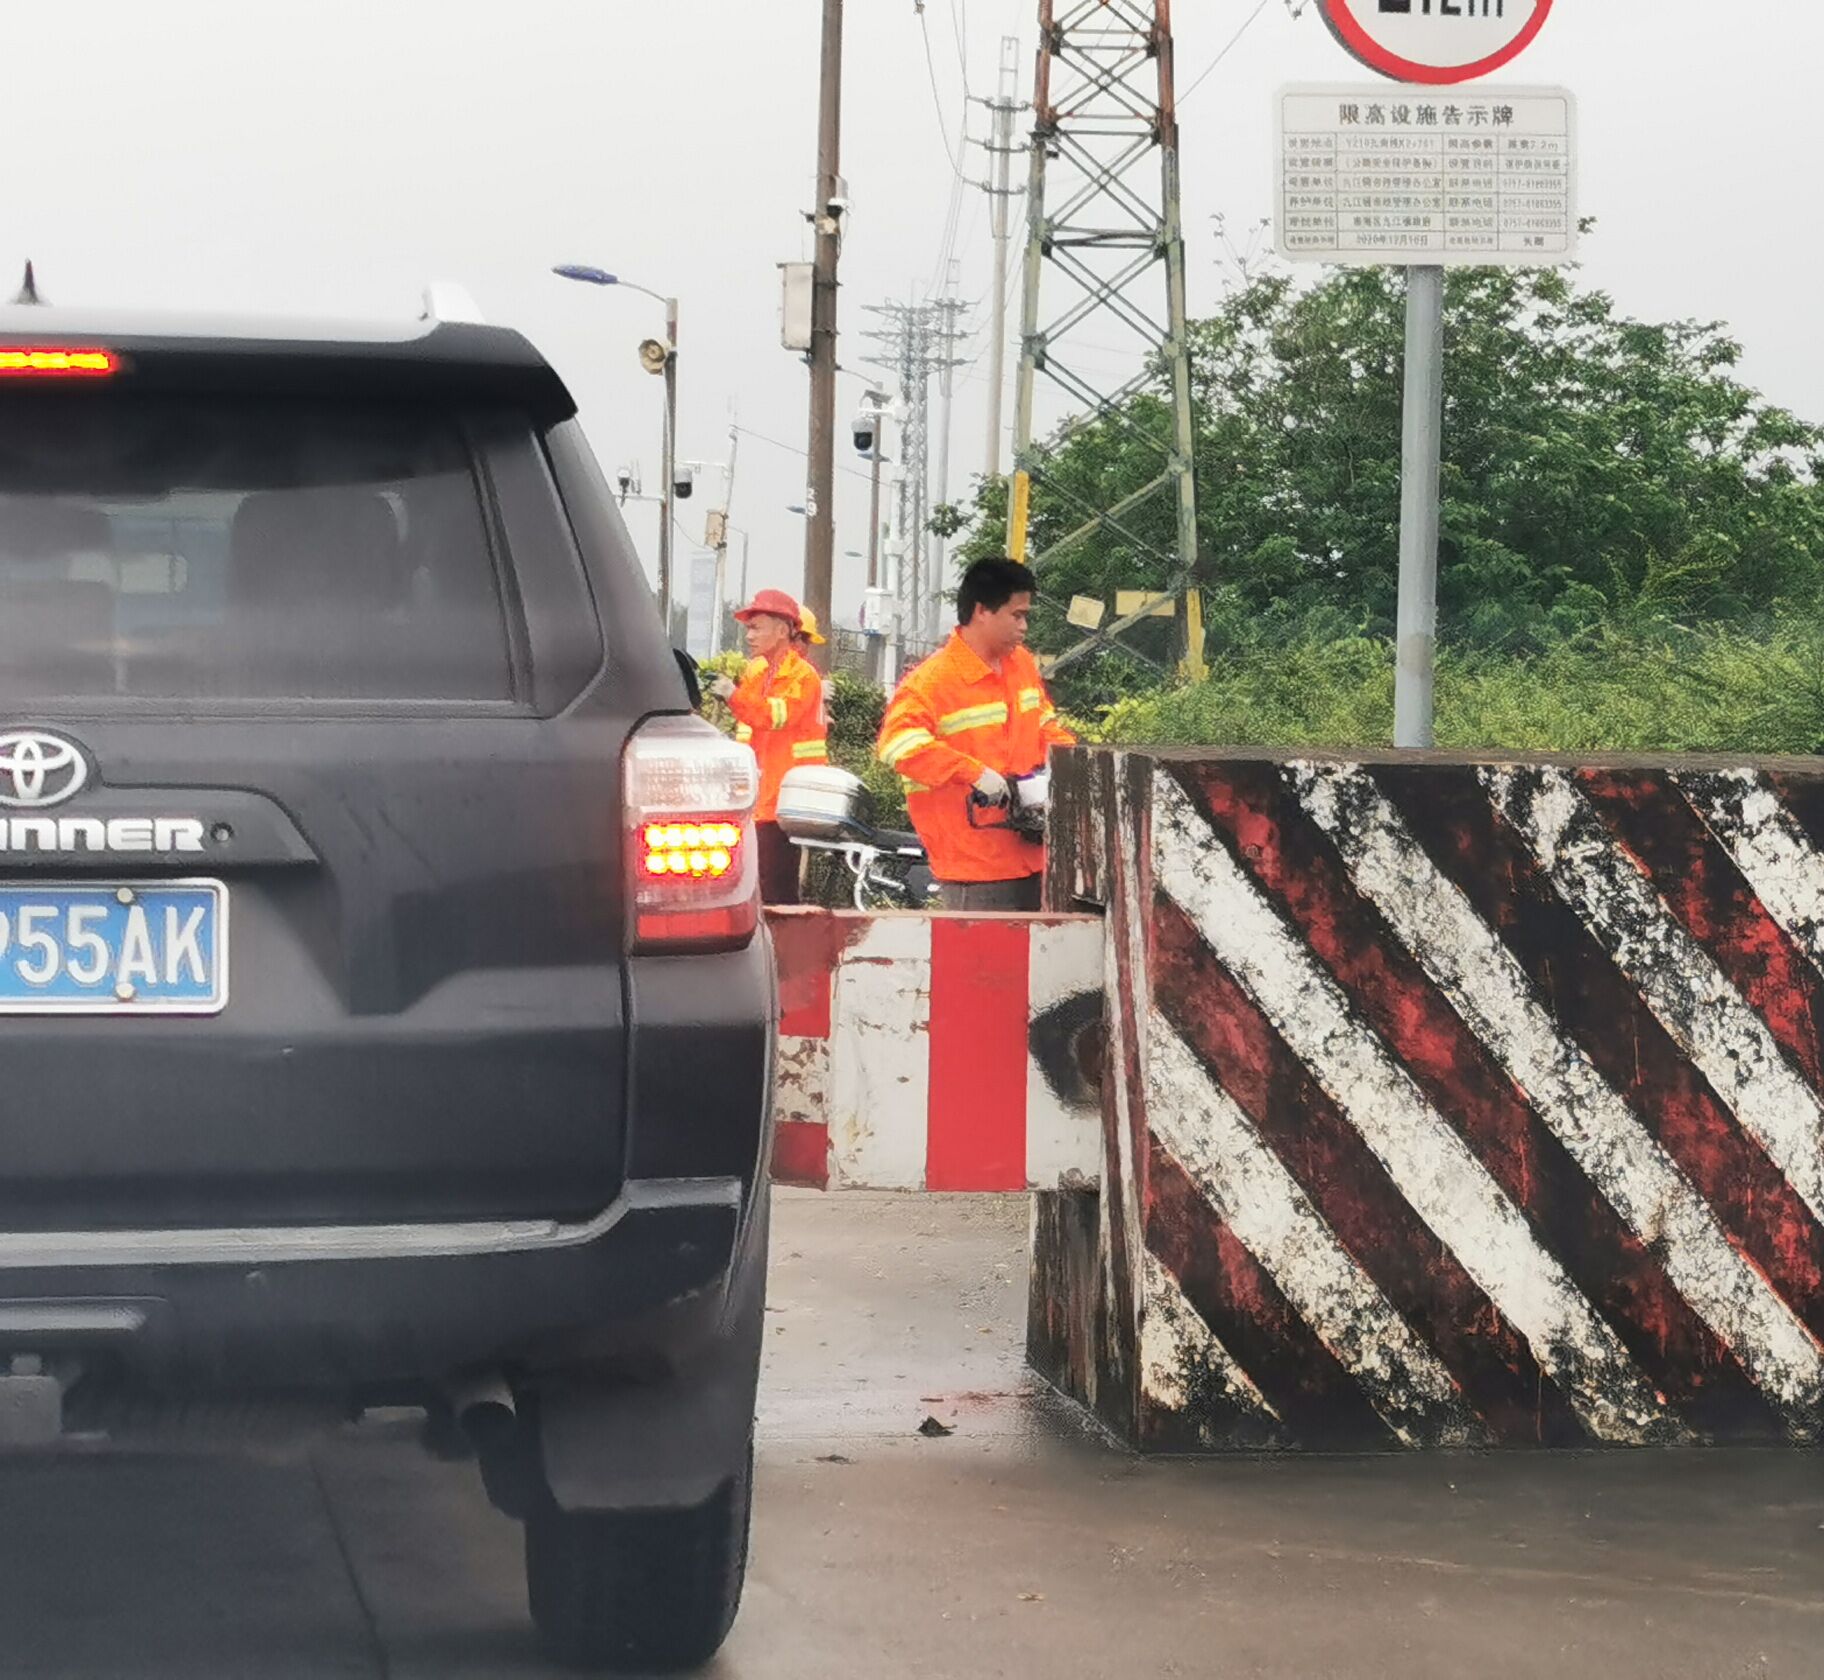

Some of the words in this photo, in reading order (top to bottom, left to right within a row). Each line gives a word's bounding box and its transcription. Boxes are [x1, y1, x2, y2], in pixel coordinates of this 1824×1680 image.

[1339, 104, 1514, 126] 限高设施告示牌
[0, 818, 206, 851] NNER
[0, 906, 206, 985] 55AK
